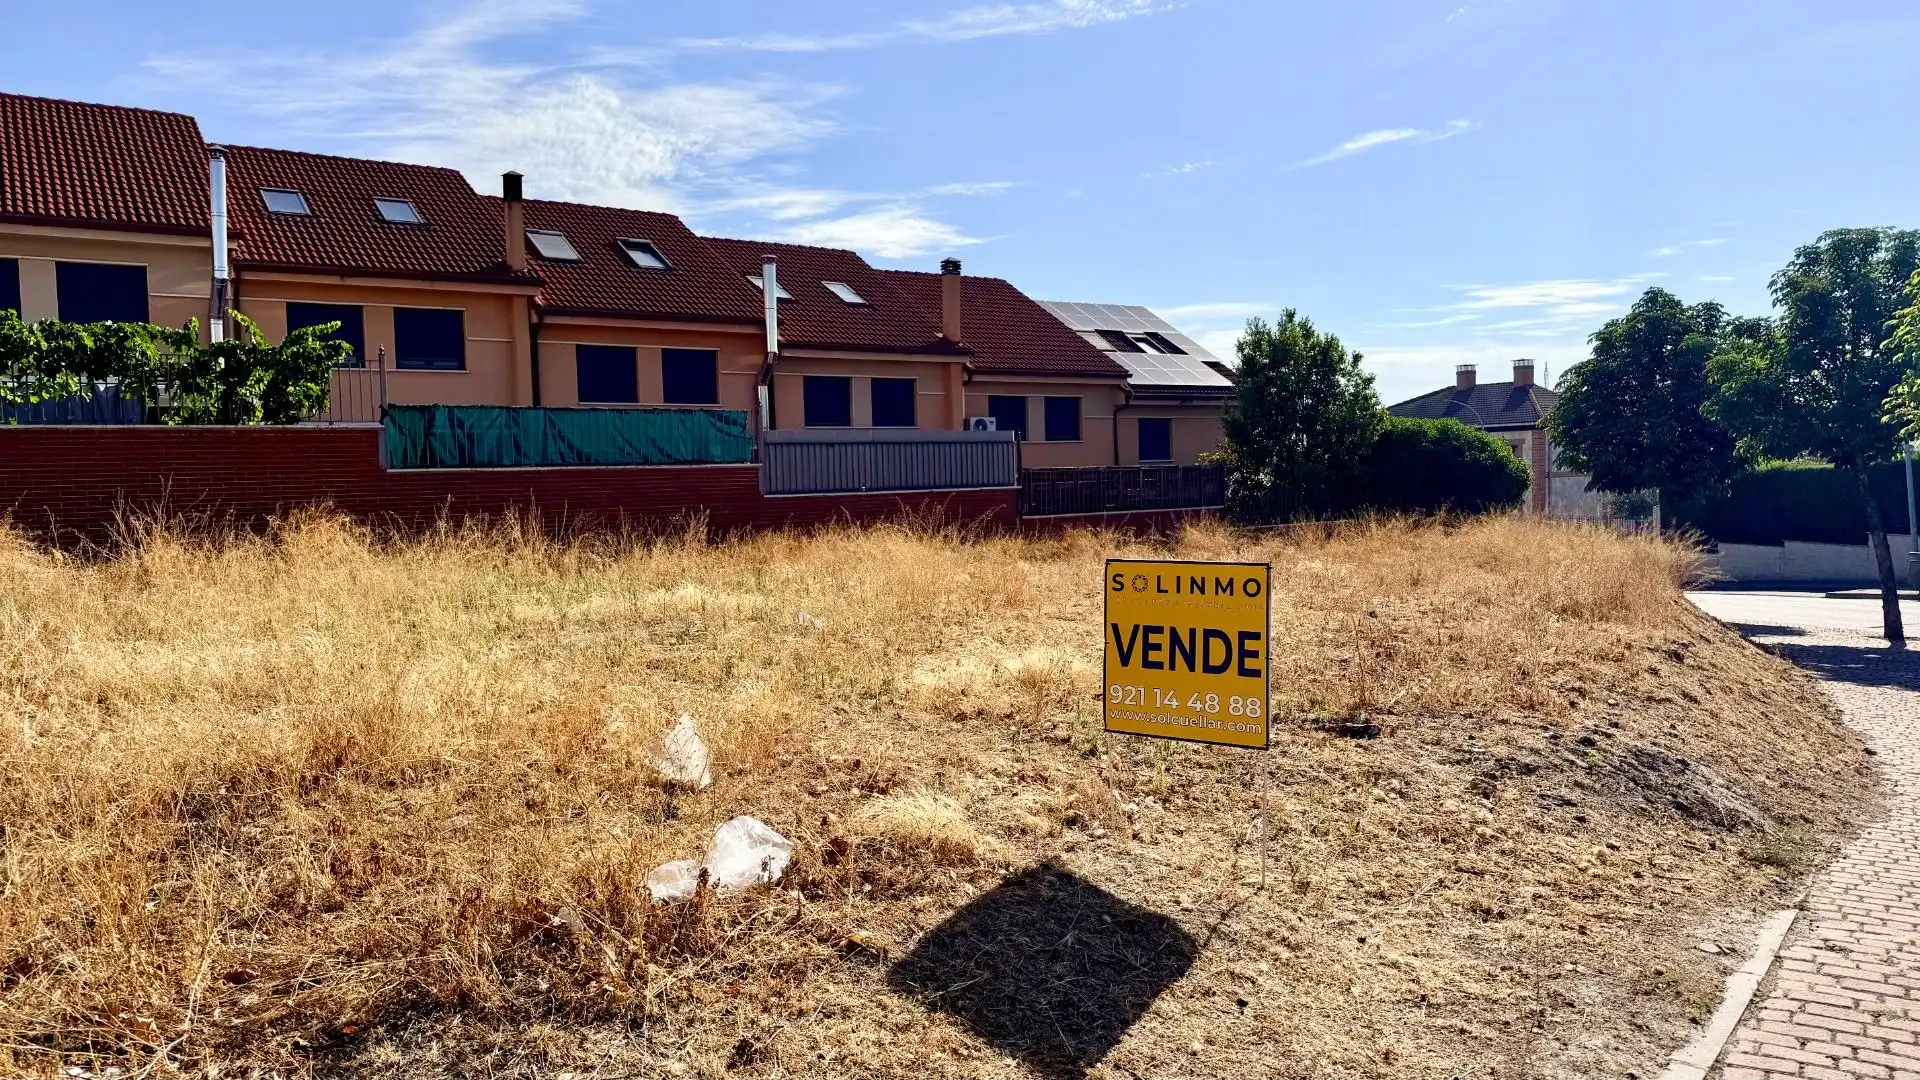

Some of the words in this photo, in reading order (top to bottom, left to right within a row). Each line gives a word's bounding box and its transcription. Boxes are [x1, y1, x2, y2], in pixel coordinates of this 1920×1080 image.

[1112, 573, 1262, 598] SOLINMO
[1111, 622, 1262, 678] VENDE
[1109, 684, 1146, 706] 921
[1153, 687, 1180, 709] 14
[1186, 692, 1220, 714] 48
[1228, 695, 1262, 718] 88
[1110, 708, 1262, 734] www.solcuellar.com
